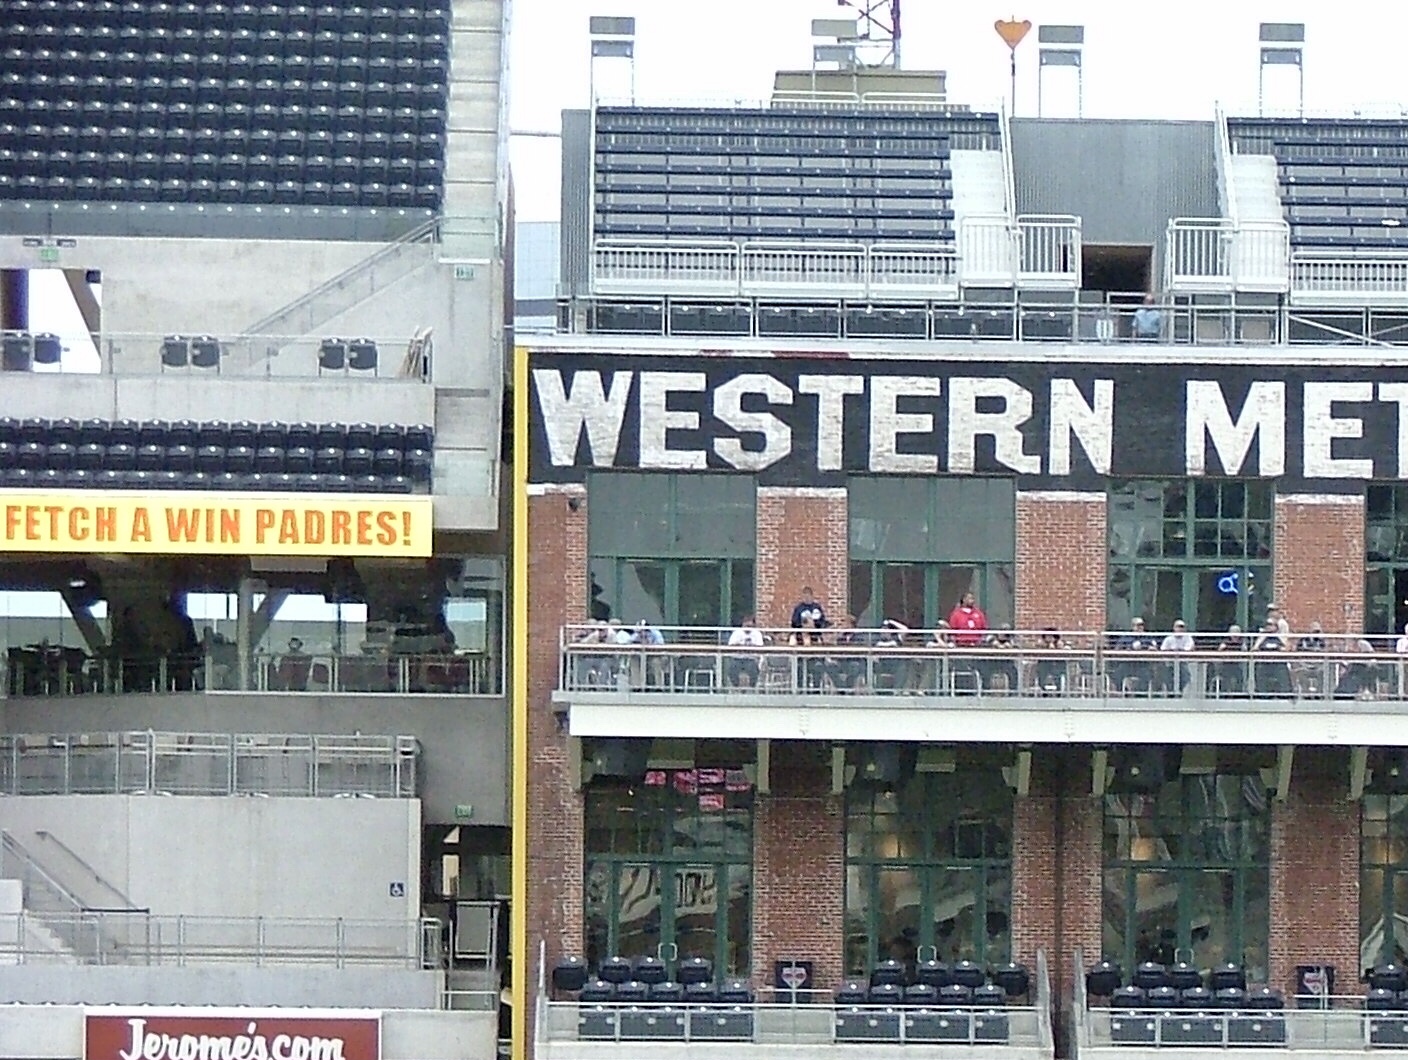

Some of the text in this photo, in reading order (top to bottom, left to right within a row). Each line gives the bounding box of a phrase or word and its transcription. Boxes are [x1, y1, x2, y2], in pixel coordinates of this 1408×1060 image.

[532, 369, 1114, 474] WESTERN
[5, 504, 412, 547] FETCH A WIN PADRES!
